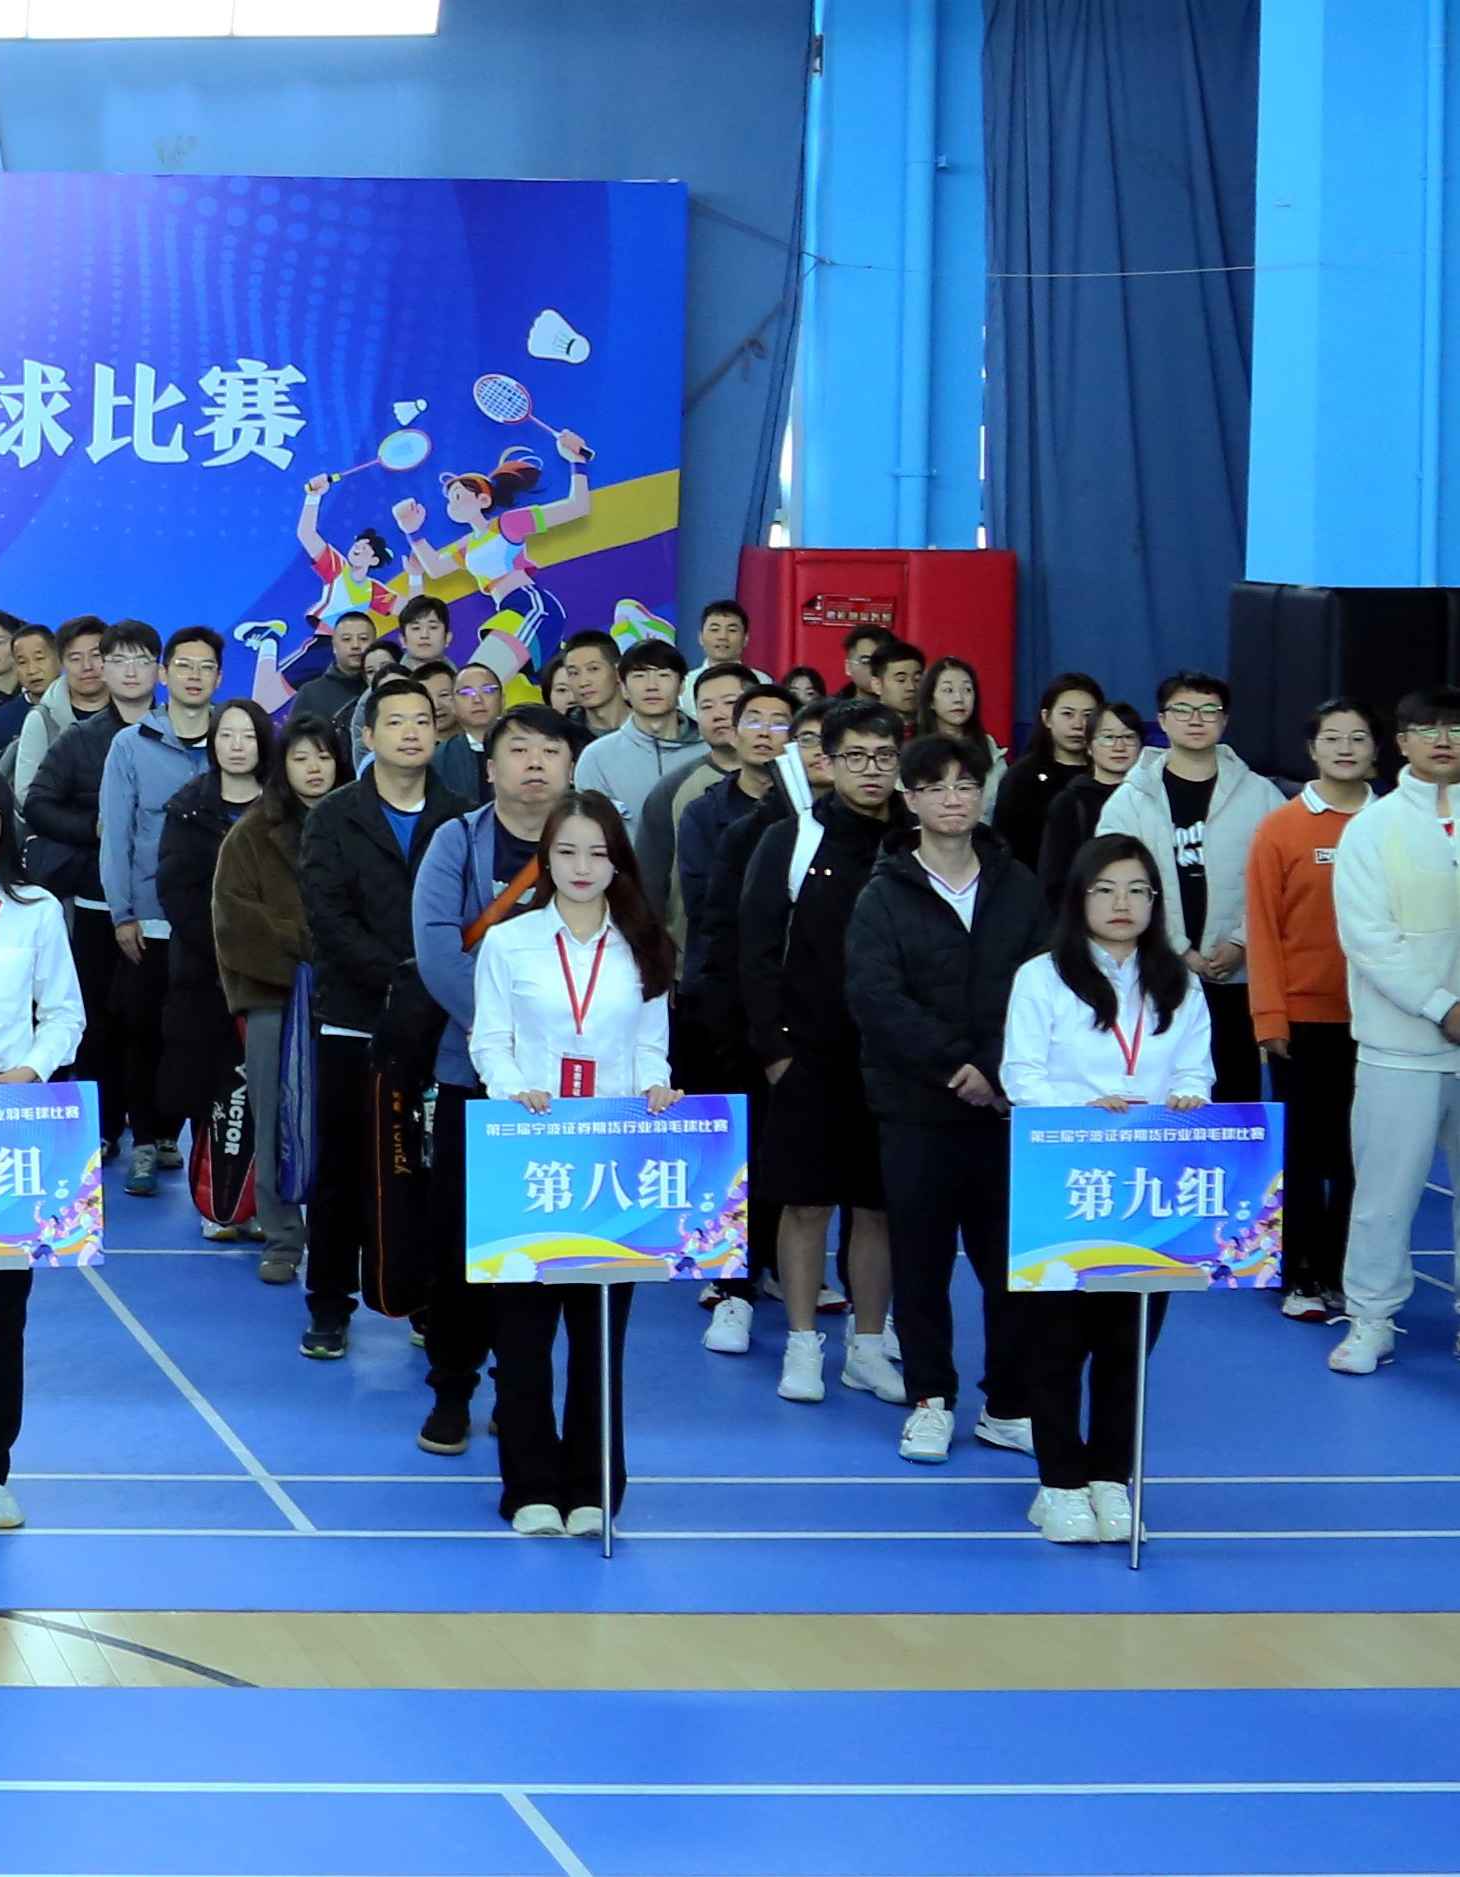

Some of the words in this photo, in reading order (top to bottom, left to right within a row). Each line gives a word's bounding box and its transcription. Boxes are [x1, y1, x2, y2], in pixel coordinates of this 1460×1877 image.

[224, 1085, 248, 1156] VICTOR
[522, 1158, 693, 1214] 第八组
[1064, 1166, 1229, 1221] 第九组
